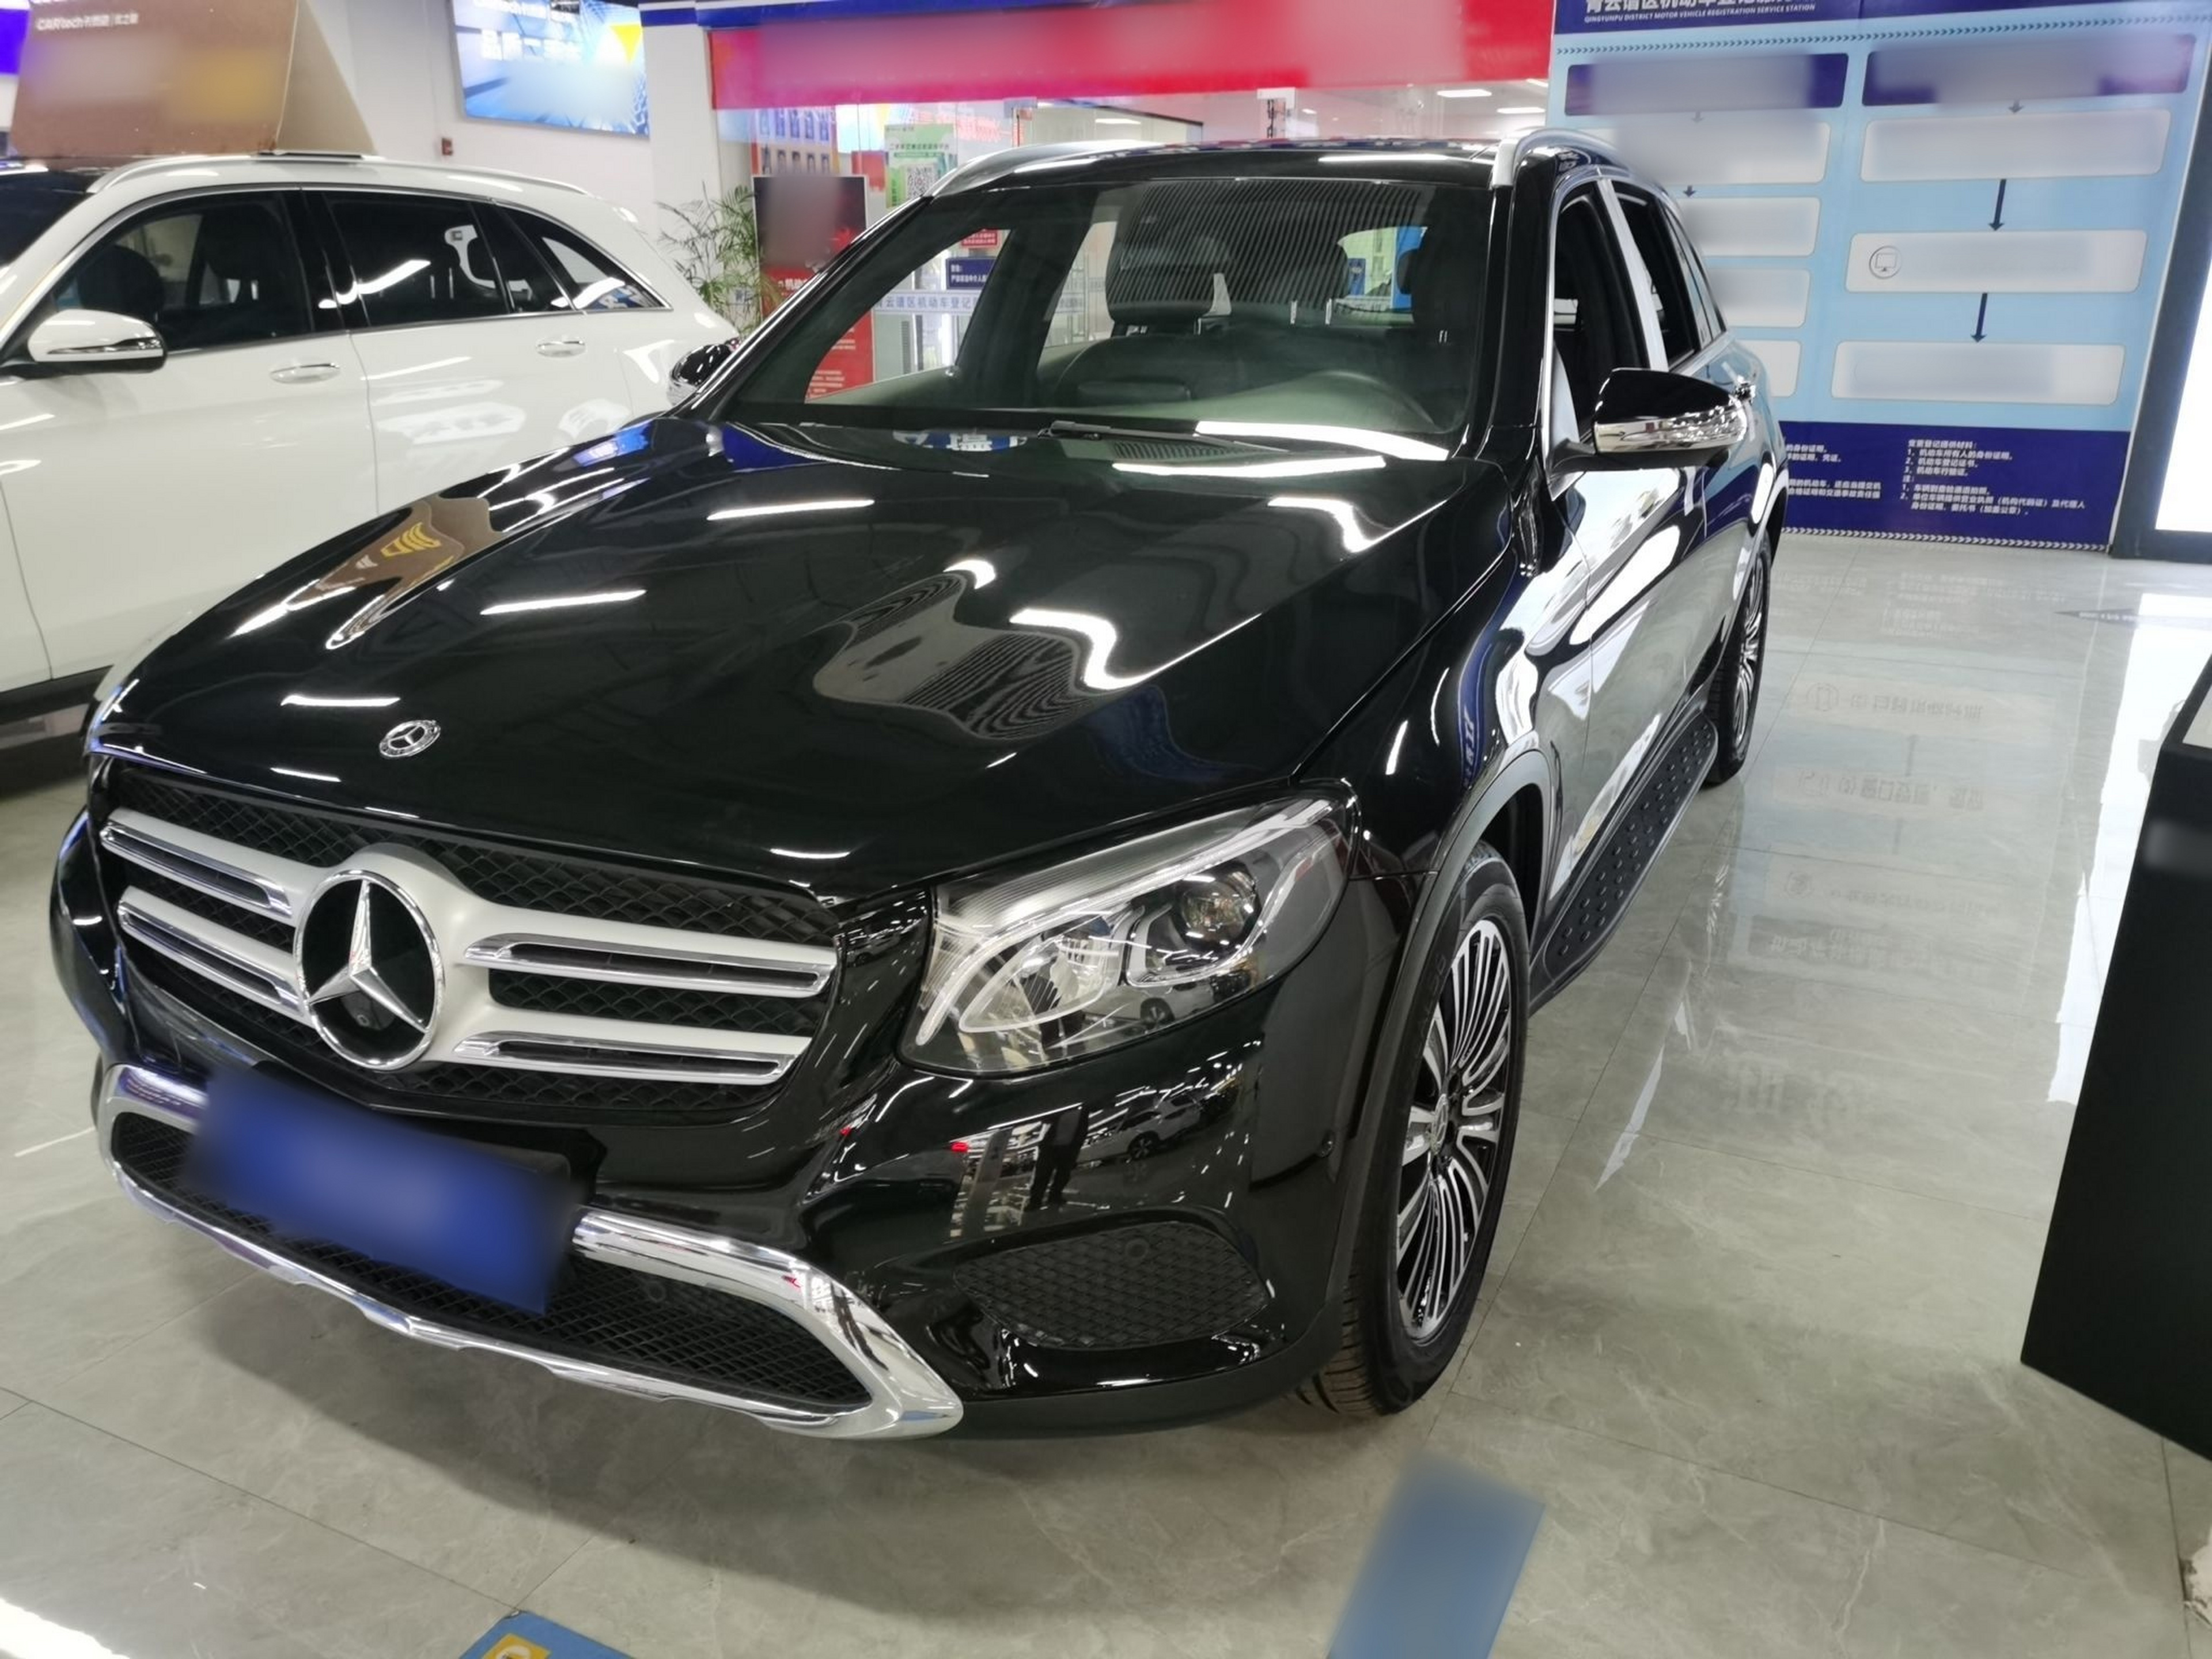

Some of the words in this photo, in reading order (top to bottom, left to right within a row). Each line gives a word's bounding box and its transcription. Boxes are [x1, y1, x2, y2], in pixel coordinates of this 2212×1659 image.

[1624, 12, 1653, 21] DISTRICT
[1654, 11, 1678, 20] MOTOR
[1680, 9, 1706, 18] VEHICLE
[1707, 6, 1756, 16] REGISTRATION
[1757, 5, 1785, 14] SERVICE
[1785, 3, 1816, 12] STATION
